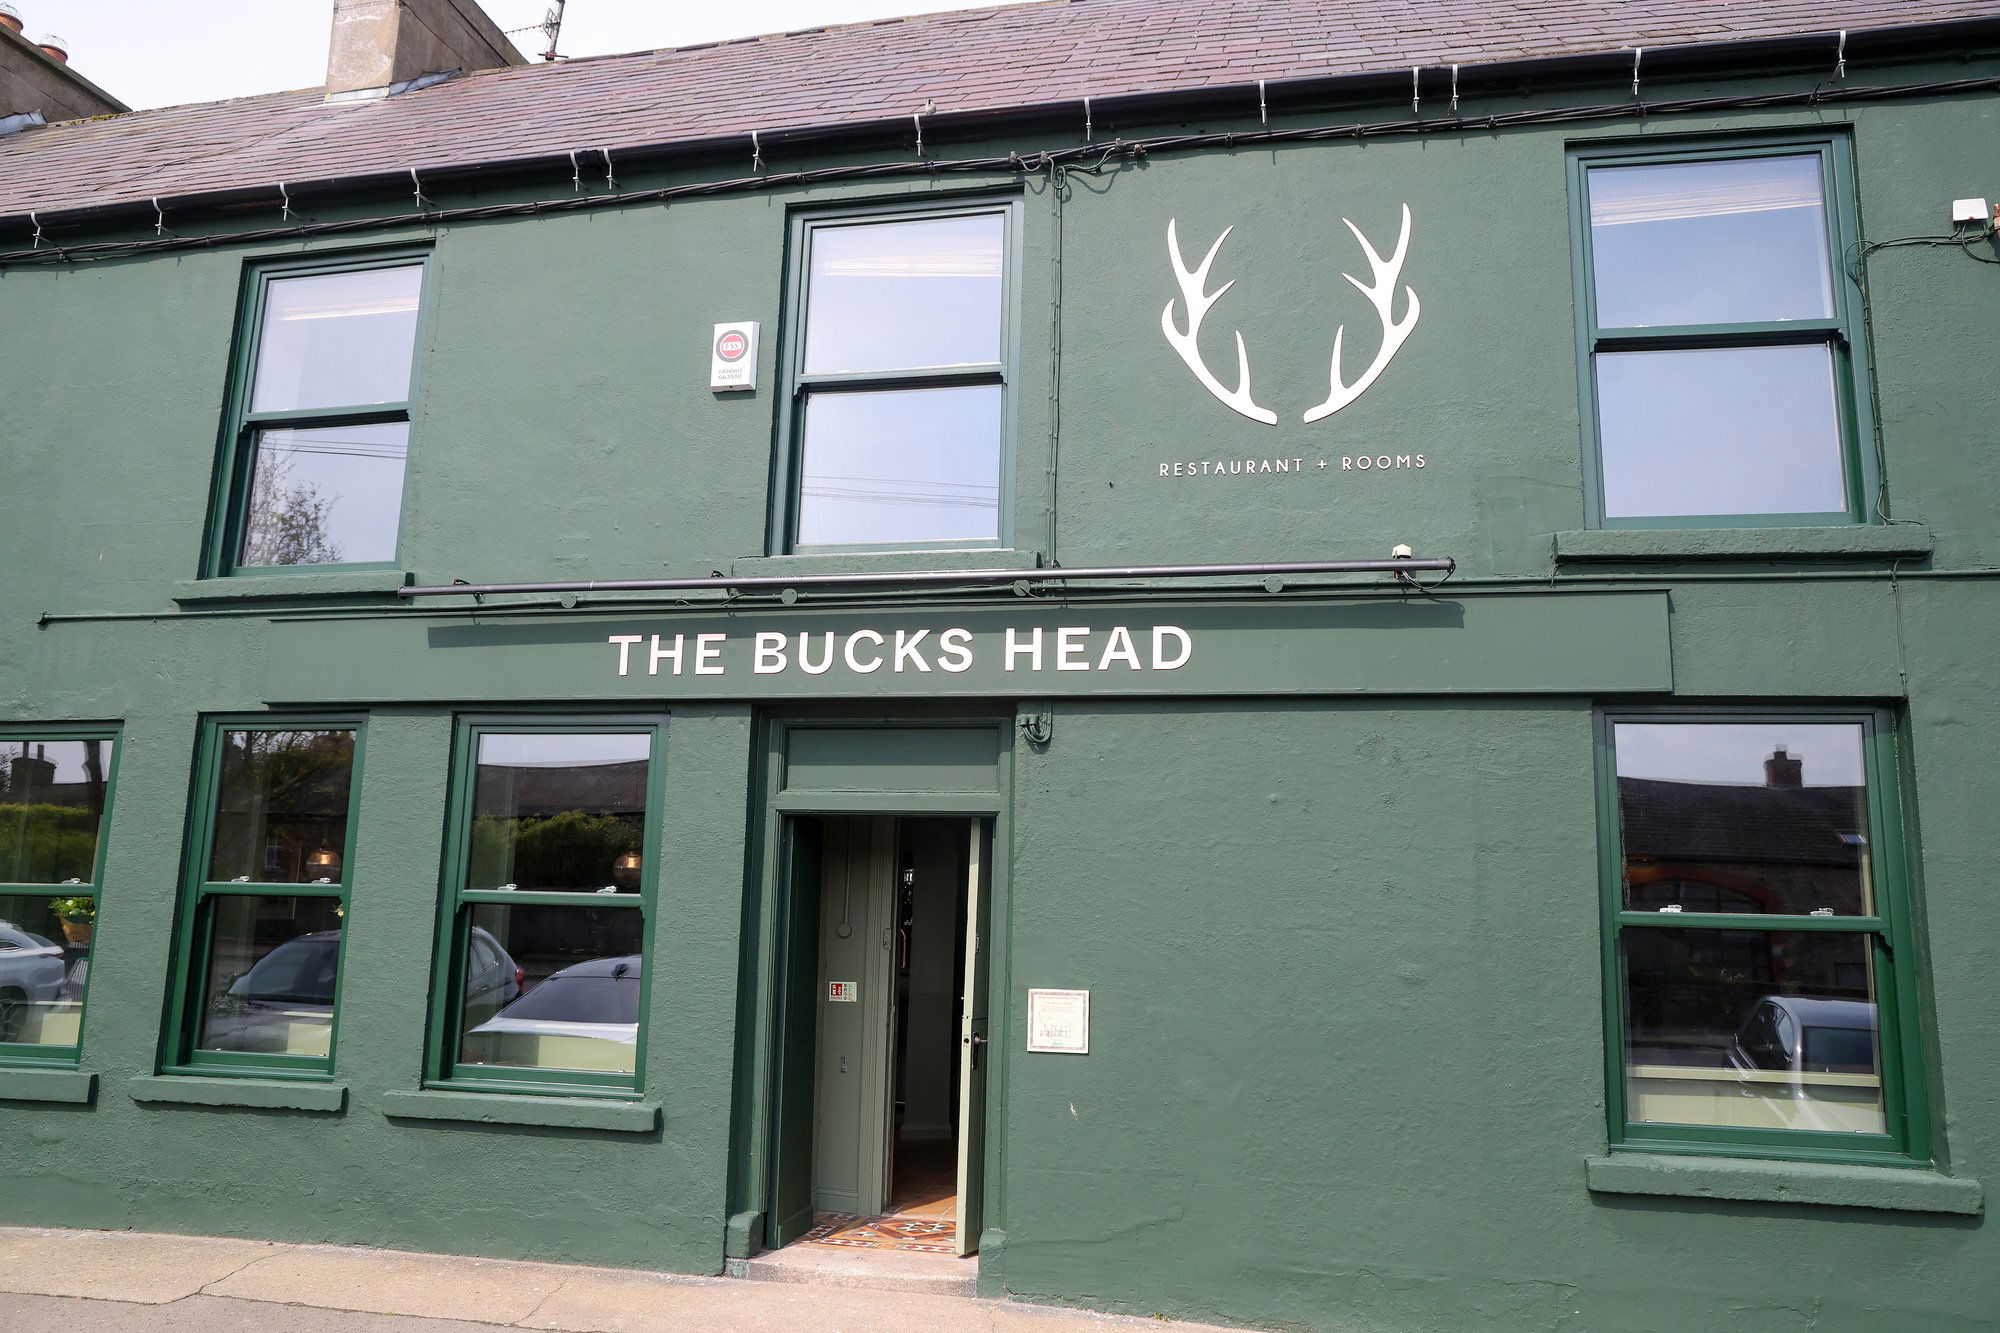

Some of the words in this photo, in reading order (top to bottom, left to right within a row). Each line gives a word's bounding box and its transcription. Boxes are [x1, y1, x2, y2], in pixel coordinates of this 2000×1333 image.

[1159, 457, 1303, 477] RESTAURANT
[1342, 454, 1426, 471] ROOMS
[608, 633, 727, 676] THE
[753, 627, 974, 675] BUCKS
[1004, 625, 1192, 671] HEAD
